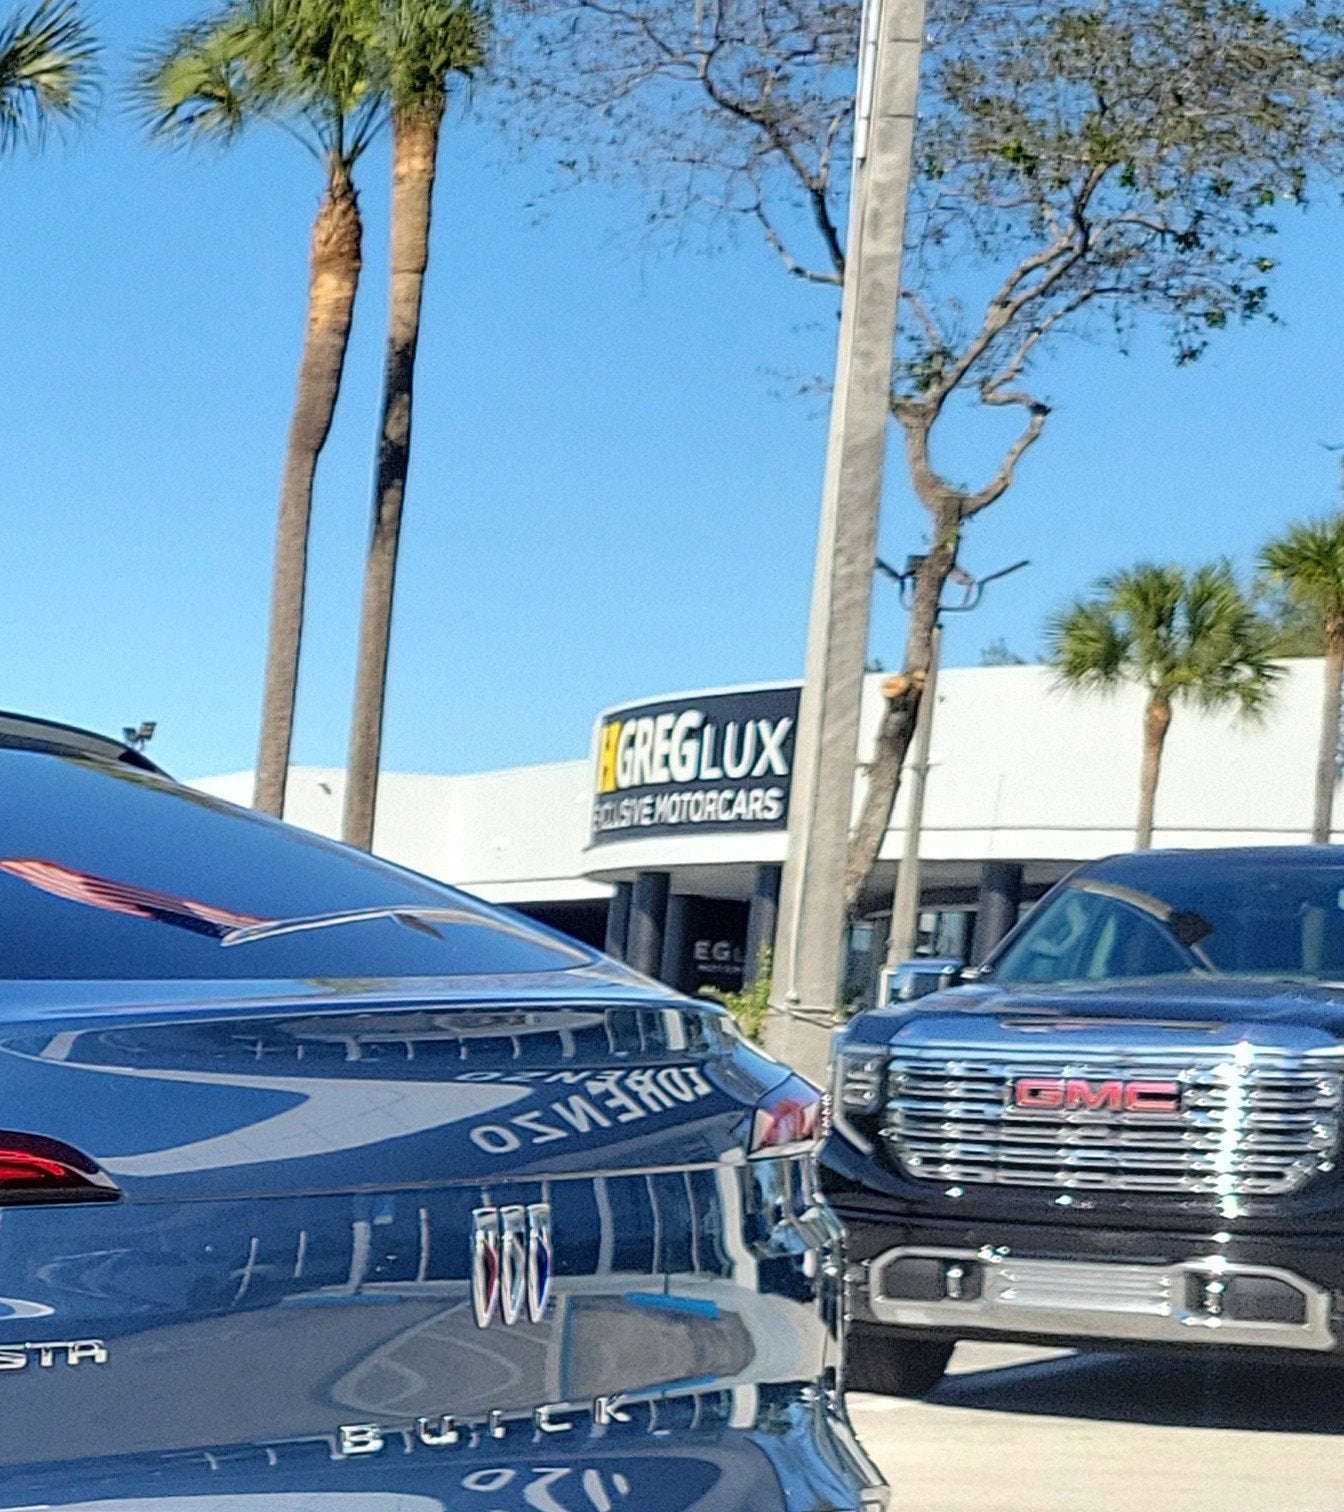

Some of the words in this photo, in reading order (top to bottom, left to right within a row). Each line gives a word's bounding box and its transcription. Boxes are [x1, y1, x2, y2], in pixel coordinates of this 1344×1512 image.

[653, 787, 785, 823] MOTORCARS
[1015, 1078, 1180, 1113] GMC
[338, 1396, 632, 1456] BUICK
